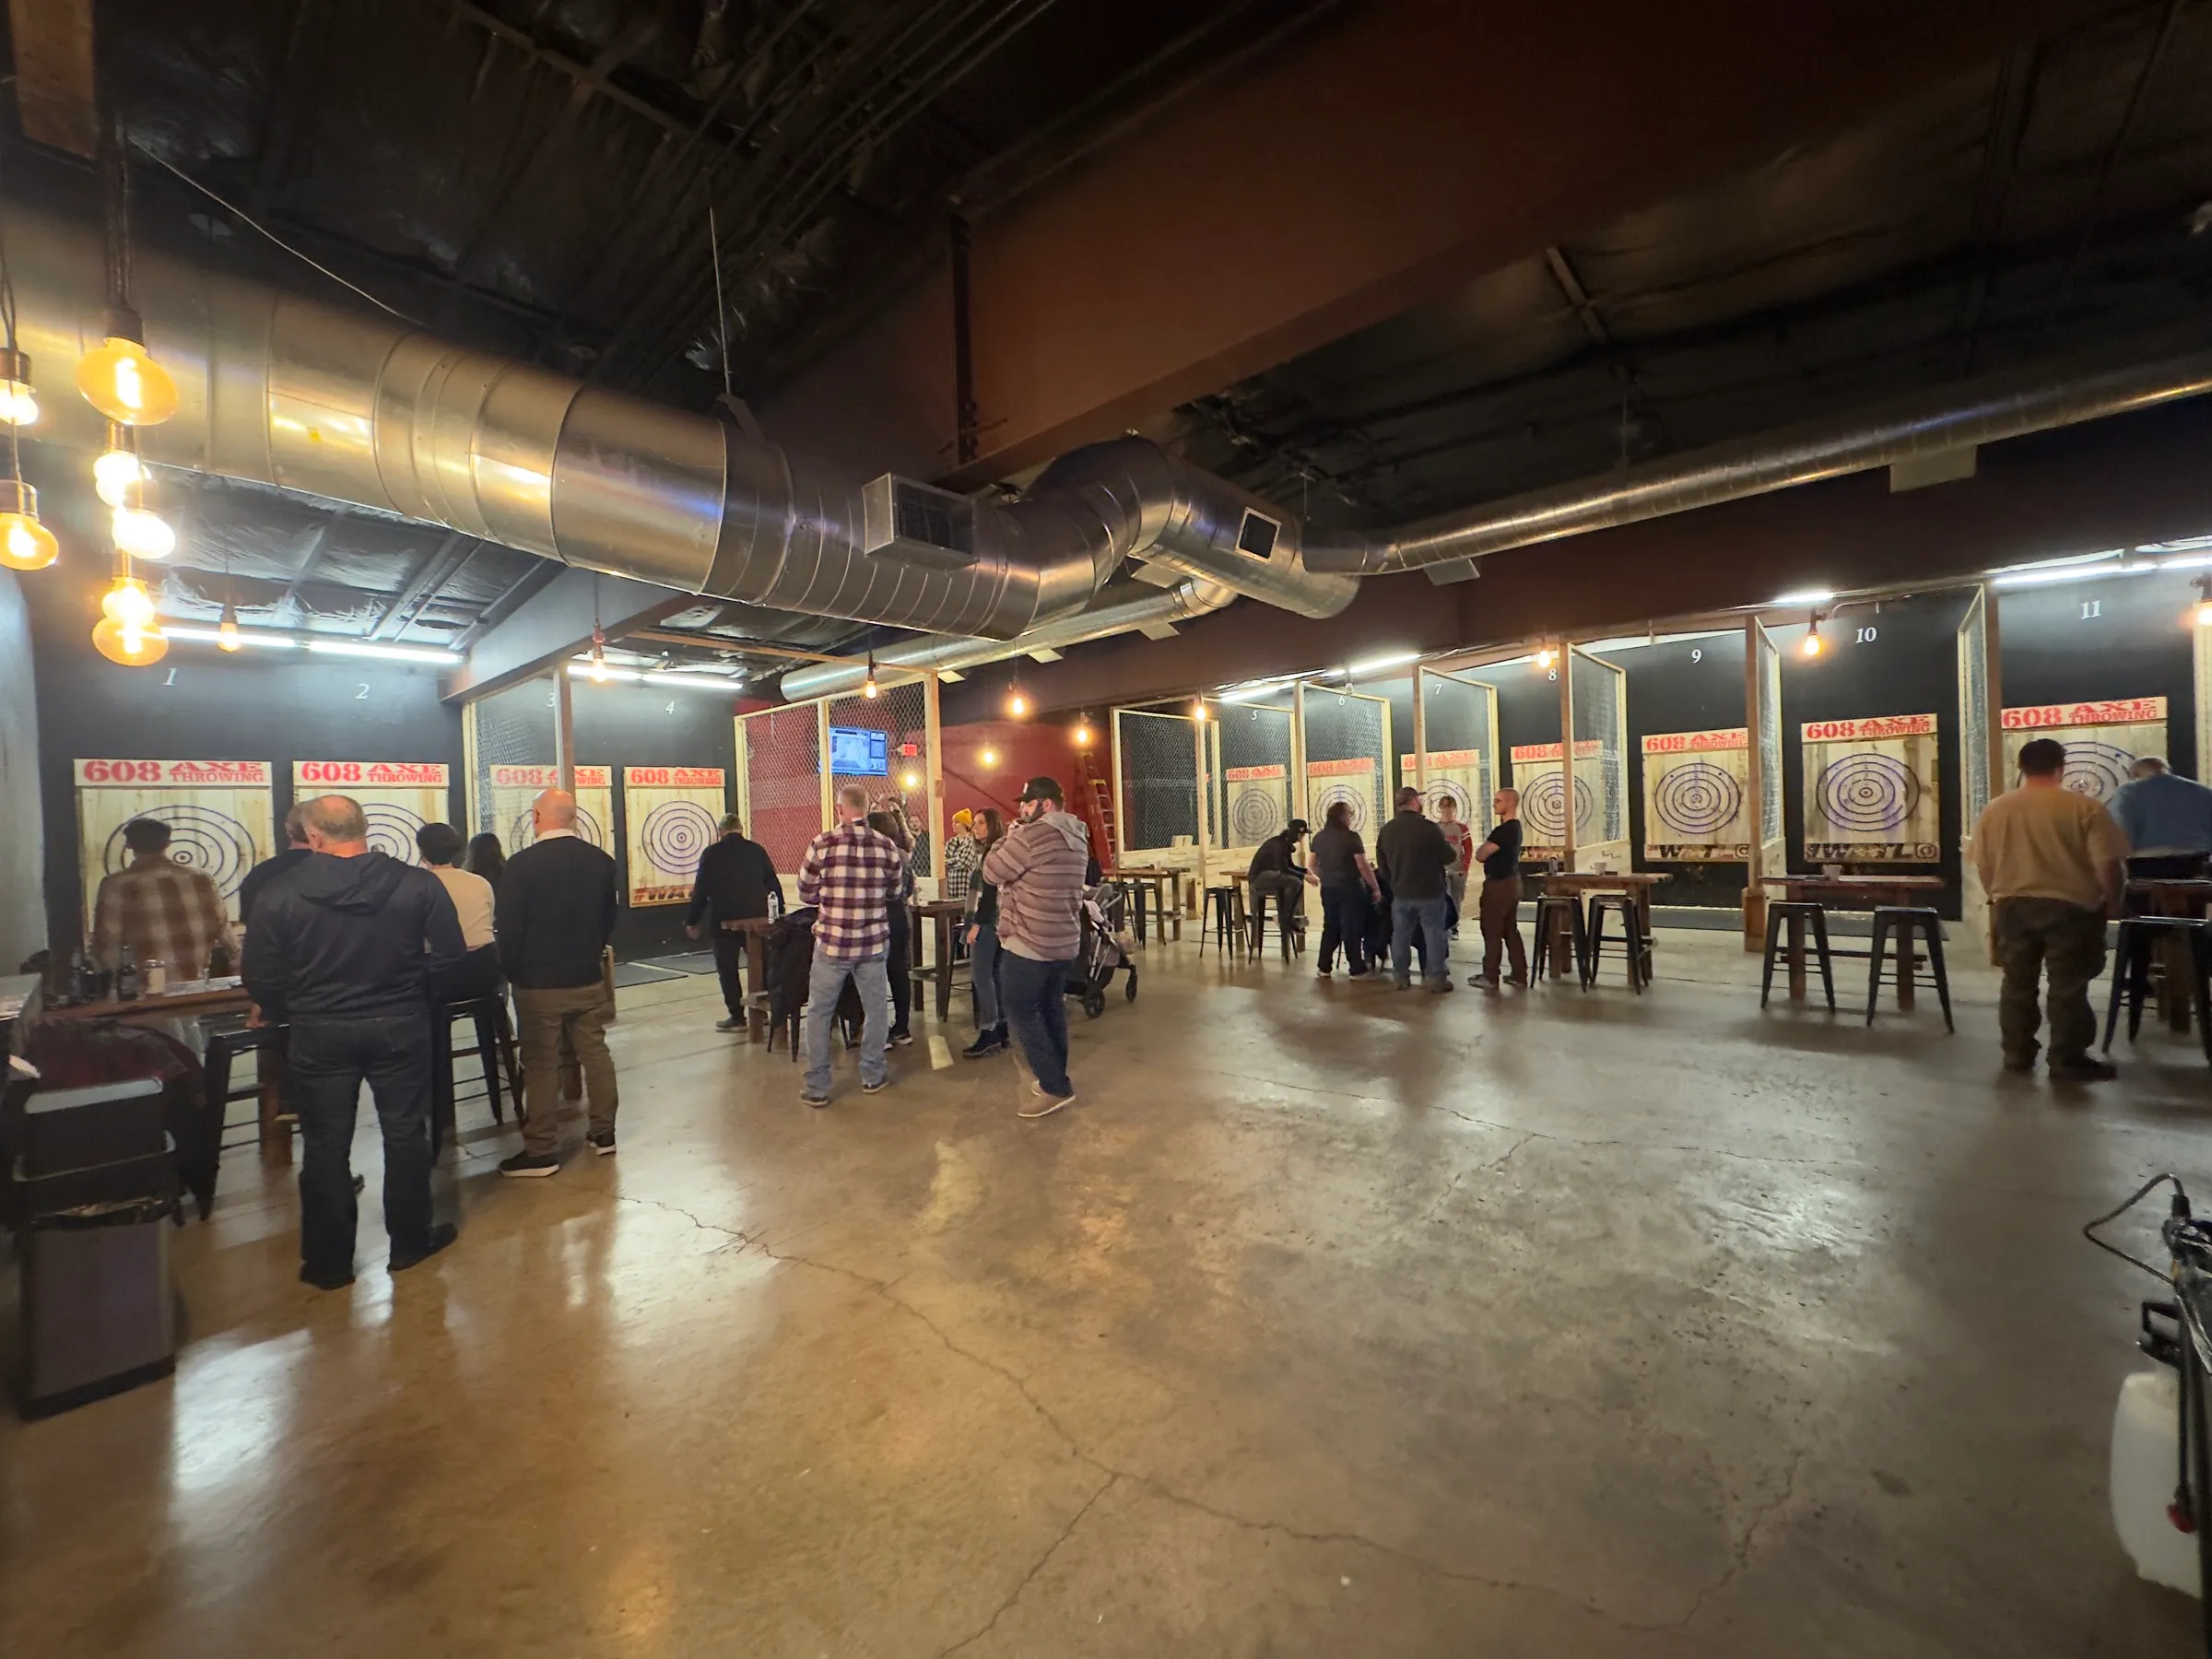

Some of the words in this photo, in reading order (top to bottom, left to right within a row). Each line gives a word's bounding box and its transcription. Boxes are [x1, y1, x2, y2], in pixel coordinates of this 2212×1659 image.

[2081, 600, 2101, 619] 11
[1855, 627, 1877, 643] 10
[1691, 649, 1702, 664] 9
[163, 667, 177, 685] 1
[1548, 668, 1558, 681] 8
[356, 683, 370, 699] 2
[1434, 683, 1443, 695] 7
[665, 700, 675, 714] 4
[1338, 695, 1346, 706] 6
[1251, 710, 1258, 721] 5
[2003, 707, 2063, 728] 608
[2074, 700, 2157, 714] AXE
[2068, 710, 2158, 724] THROWING
[1806, 722, 1855, 738] 608
[1862, 715, 1929, 727] AXE
[1646, 736, 1686, 751] 608
[1690, 732, 1747, 741] AXE
[1514, 746, 1547, 759] 608
[84, 761, 161, 782] 608
[170, 762, 264, 772] AXE
[301, 761, 362, 782] 608
[367, 764, 441, 774] AXE
[1228, 770, 1249, 780] 608
[1309, 762, 1333, 773] 608
[170, 772, 265, 782] THROWING
[367, 773, 442, 782] THROWING
[496, 768, 543, 784] 608
[630, 769, 669, 784] 608
[674, 769, 721, 777] AXE
